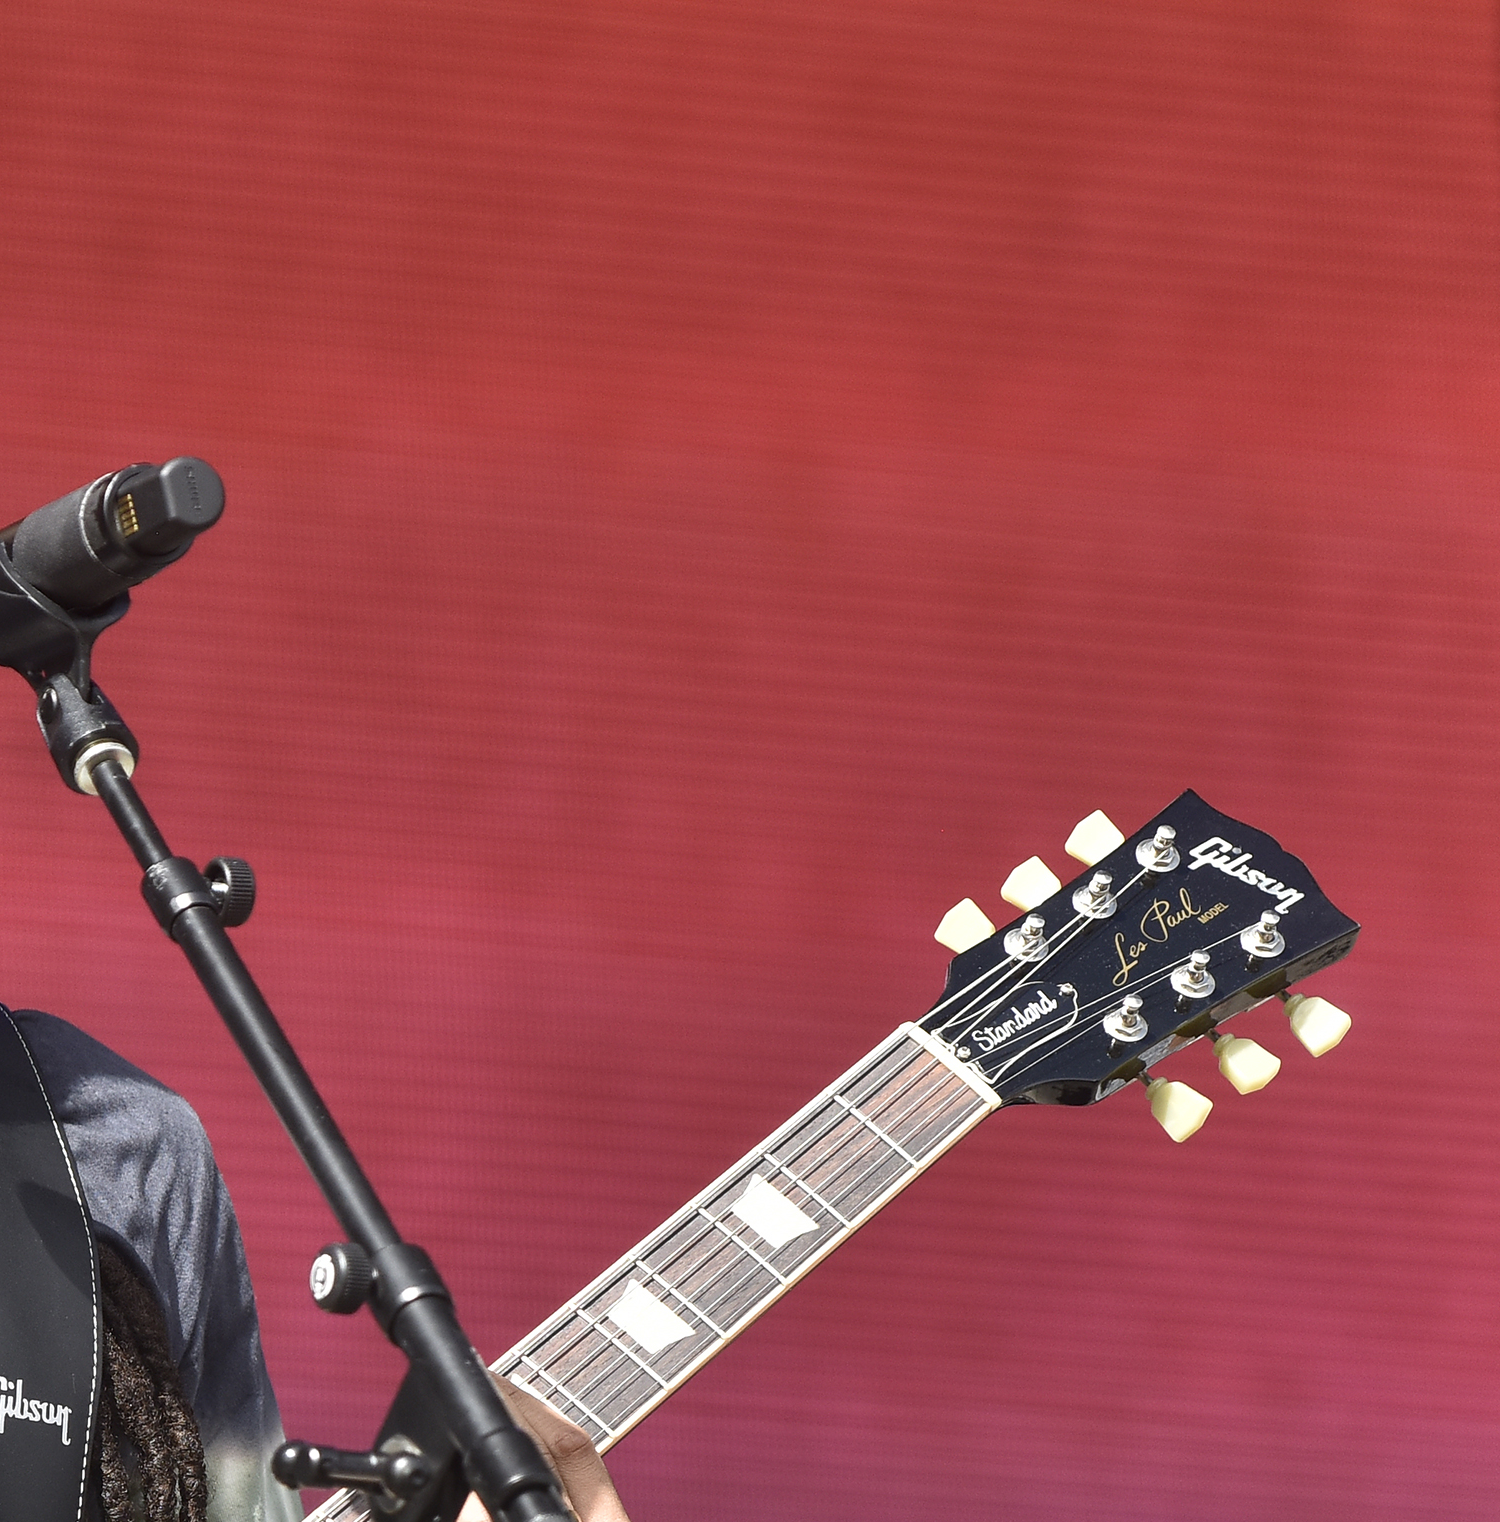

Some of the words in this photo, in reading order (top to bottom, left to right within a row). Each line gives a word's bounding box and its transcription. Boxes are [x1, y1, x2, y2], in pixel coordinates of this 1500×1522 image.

[1187, 836, 1305, 915] Gibson
[1112, 932, 1149, 987] Les
[1140, 887, 1202, 943] Paul
[1197, 902, 1230, 925] MODEL
[971, 990, 1058, 1052] Standard
